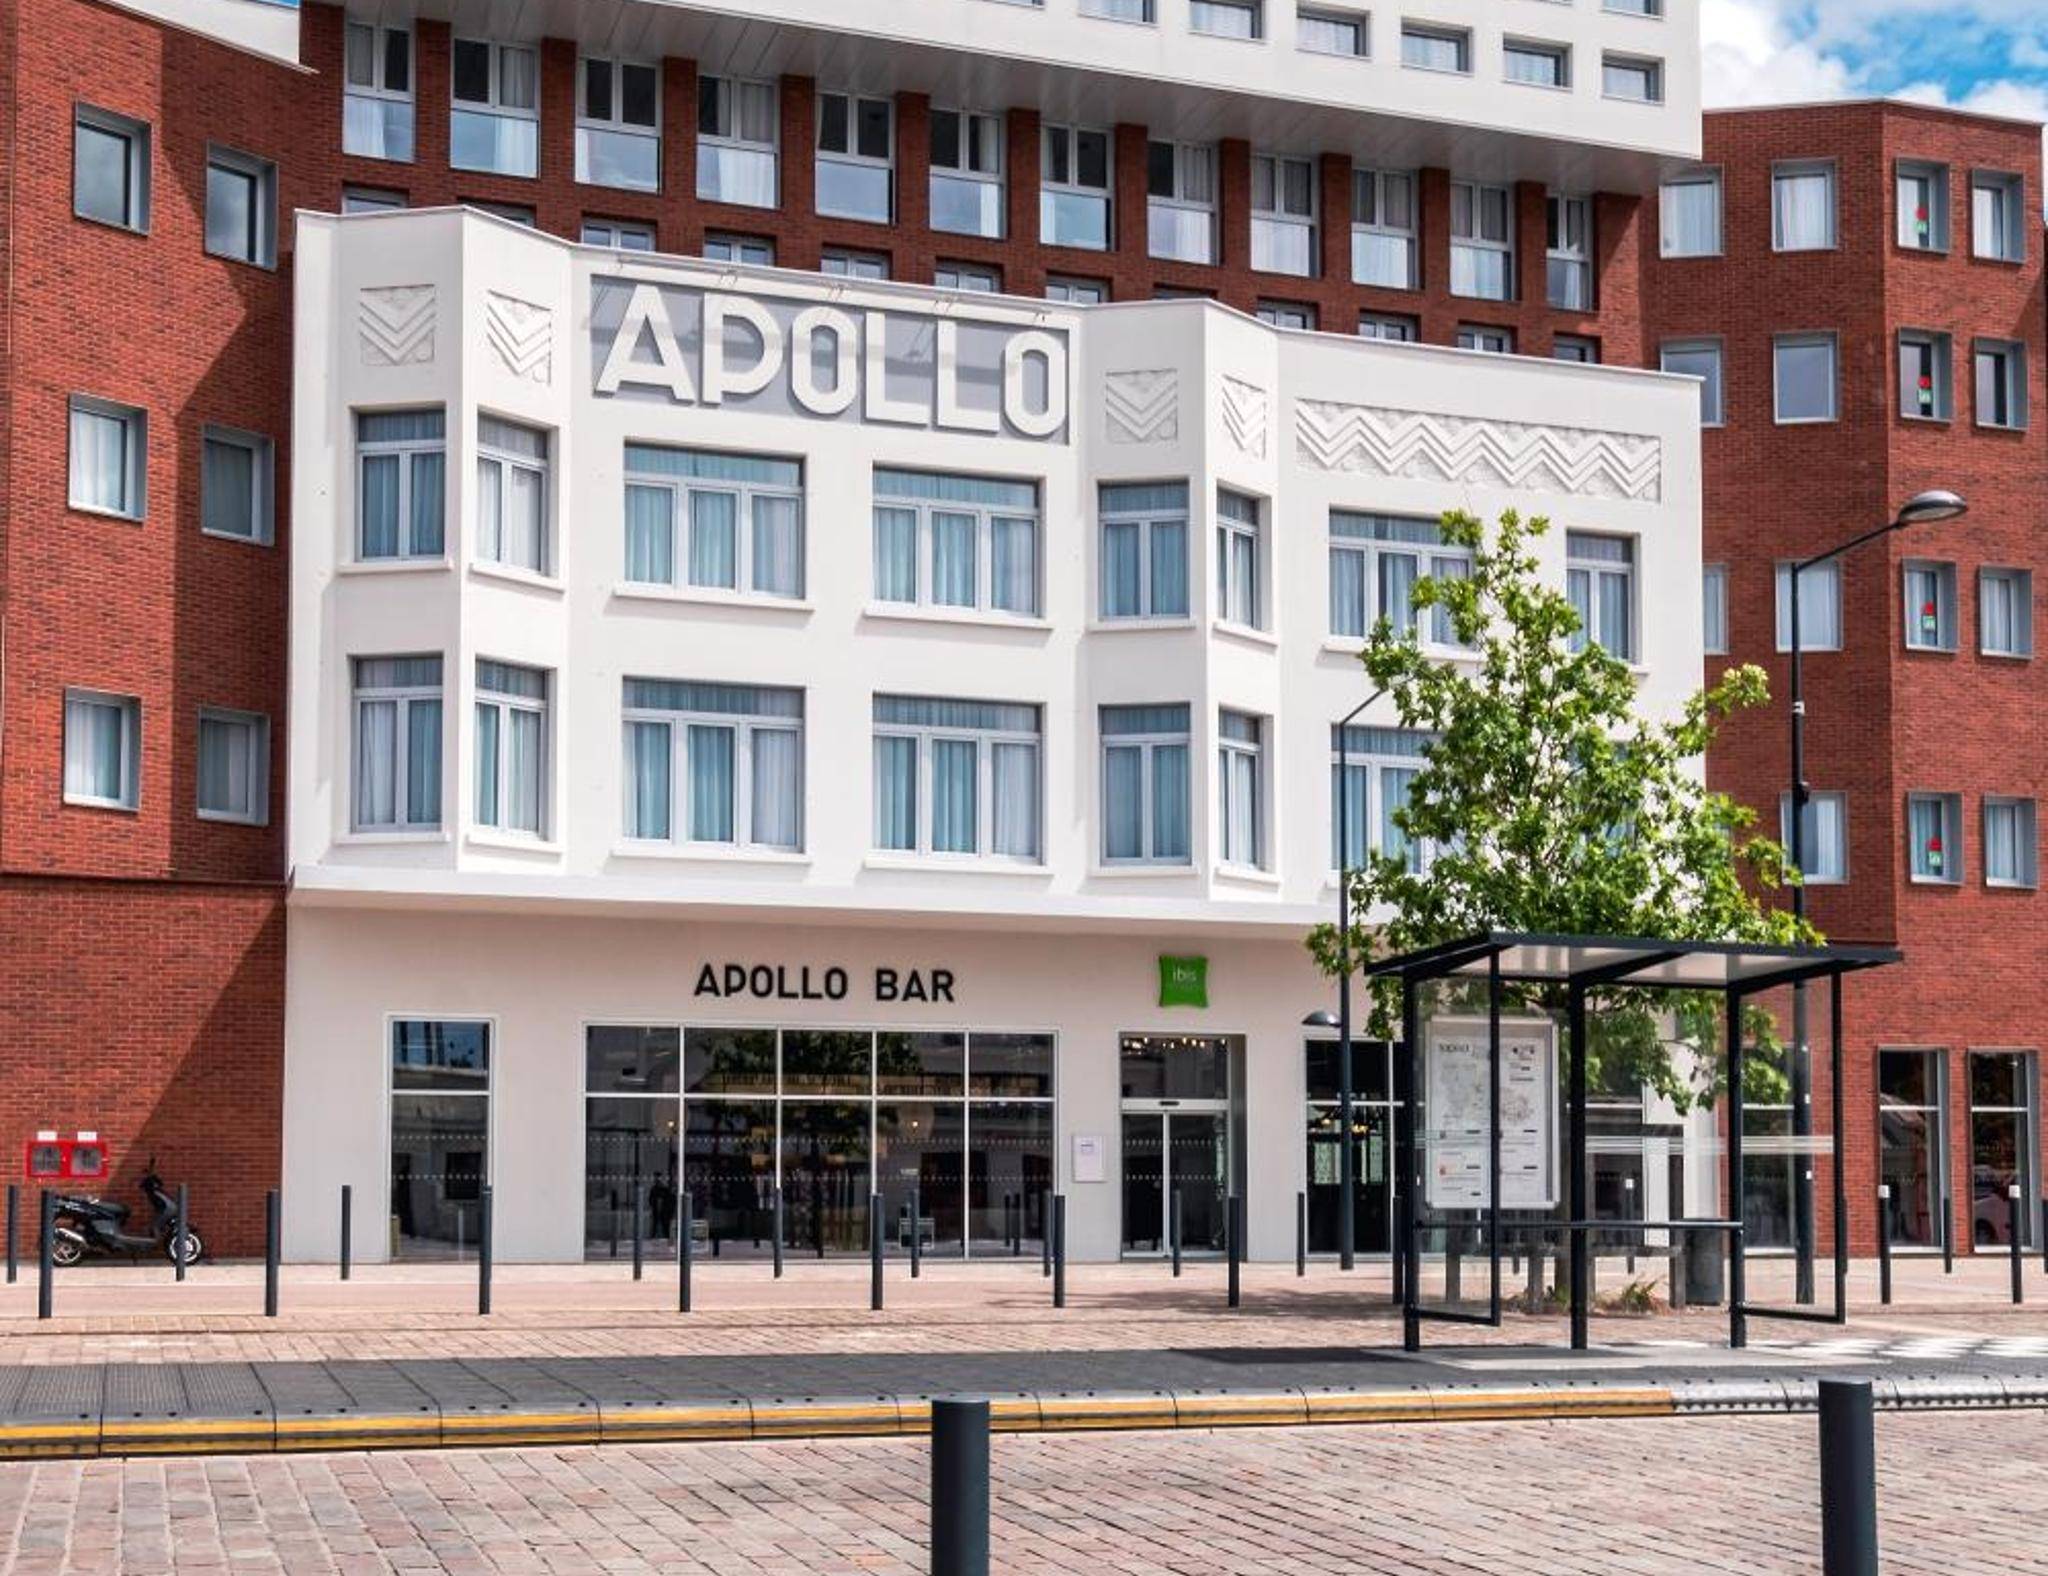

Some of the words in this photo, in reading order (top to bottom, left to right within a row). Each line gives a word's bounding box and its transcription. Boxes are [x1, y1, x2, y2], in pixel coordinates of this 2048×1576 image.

[594, 284, 1066, 437] APOLLO
[694, 963, 849, 1000] APOLLO
[875, 967, 955, 1003] BAR
[1172, 967, 1197, 982] ibis
